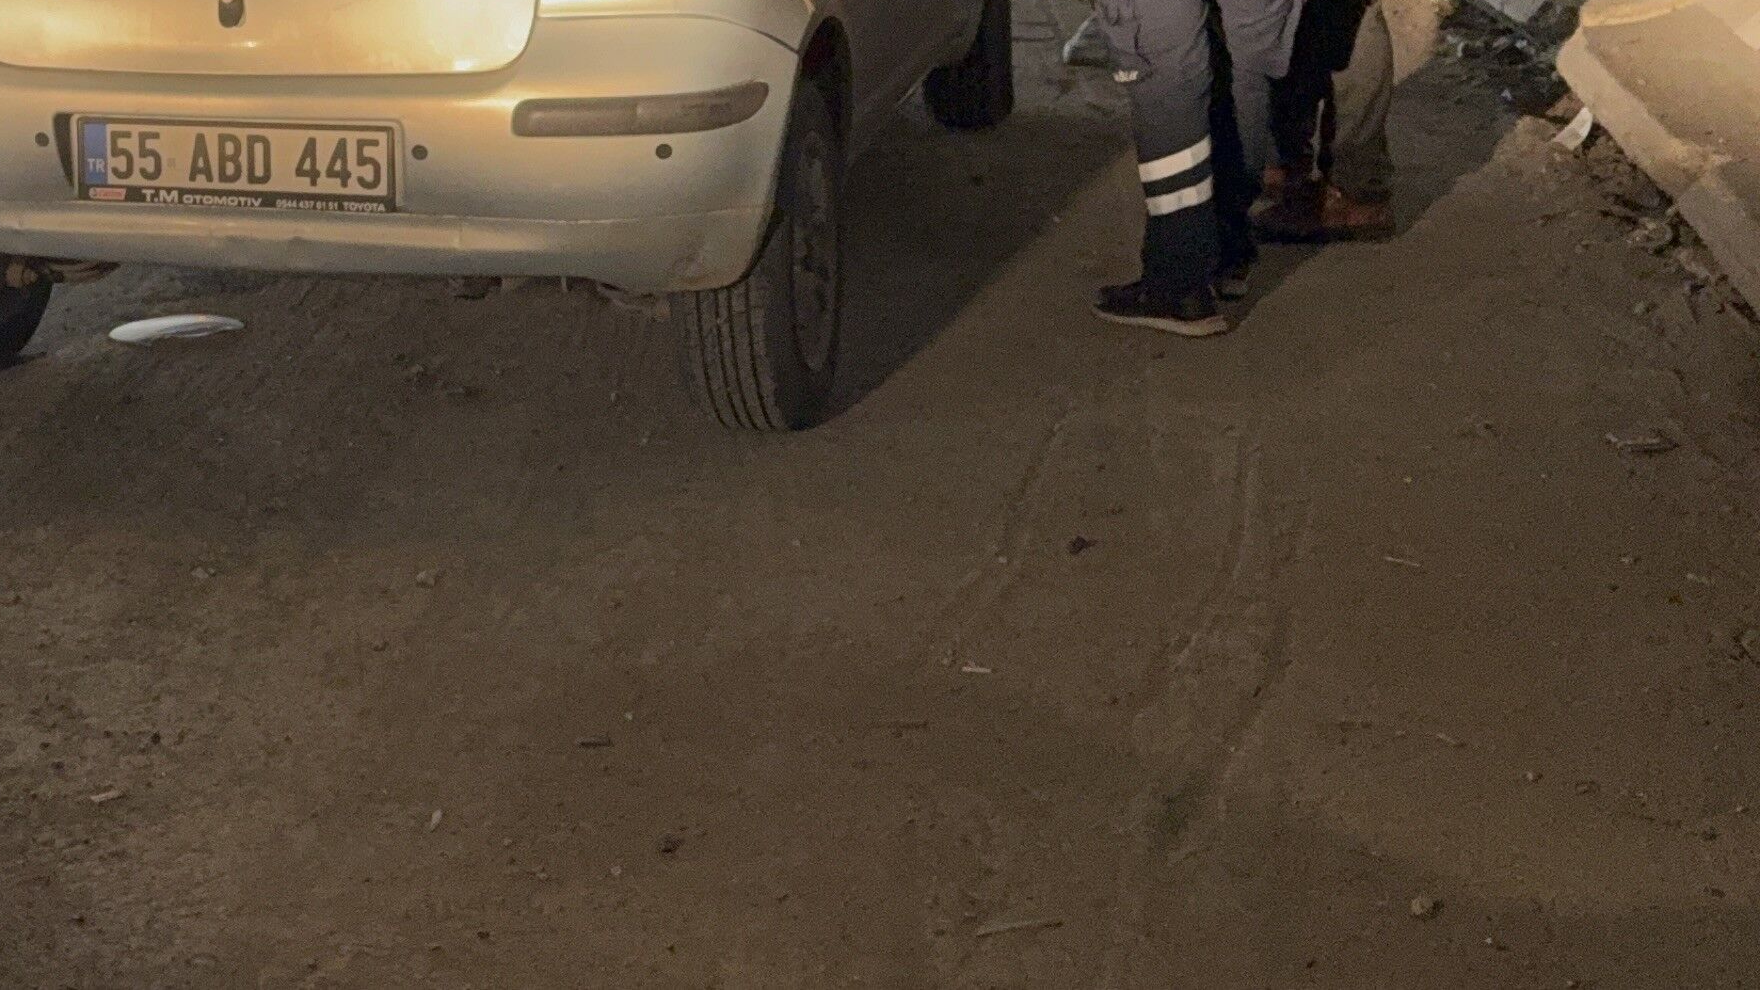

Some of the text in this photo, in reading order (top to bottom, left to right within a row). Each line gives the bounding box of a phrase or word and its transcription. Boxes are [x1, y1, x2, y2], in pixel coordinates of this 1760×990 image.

[87, 158, 106, 174] TR
[109, 130, 382, 190] 55 ABD 445
[141, 188, 179, 204] T.M
